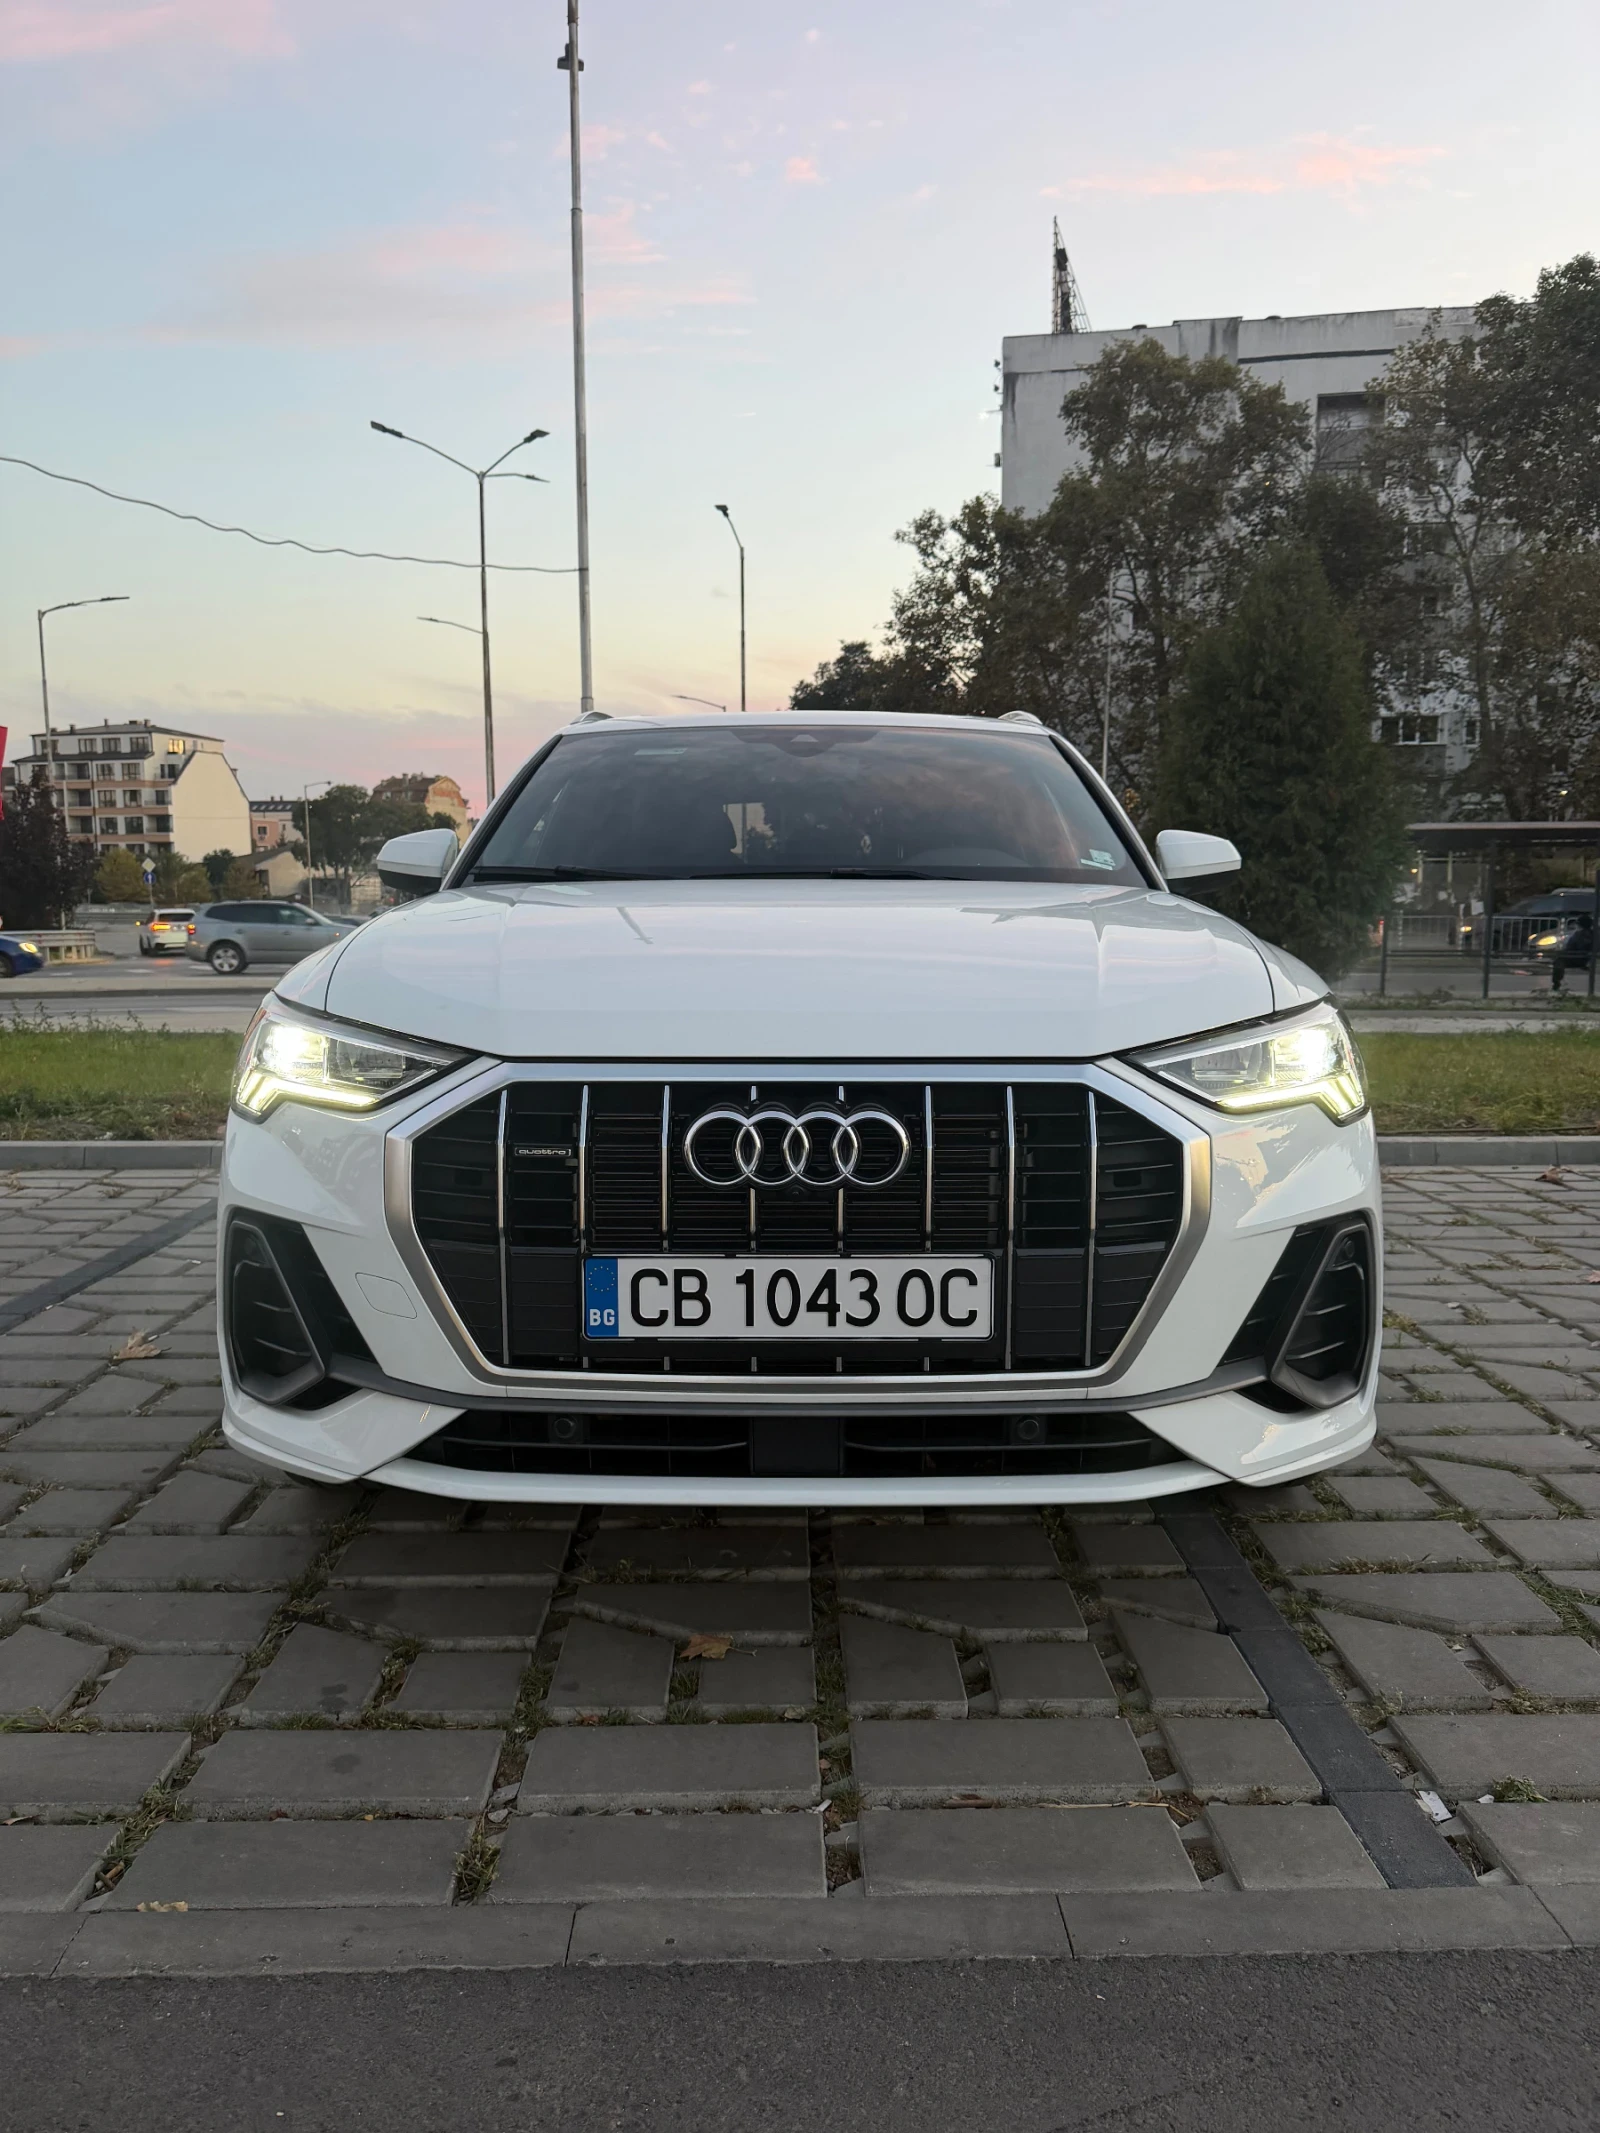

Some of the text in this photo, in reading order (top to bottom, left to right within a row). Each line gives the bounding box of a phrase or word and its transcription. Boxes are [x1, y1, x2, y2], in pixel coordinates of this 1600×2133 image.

[630, 1268, 712, 1327] CB
[735, 1268, 881, 1327] 1043
[589, 1308, 615, 1327] BG
